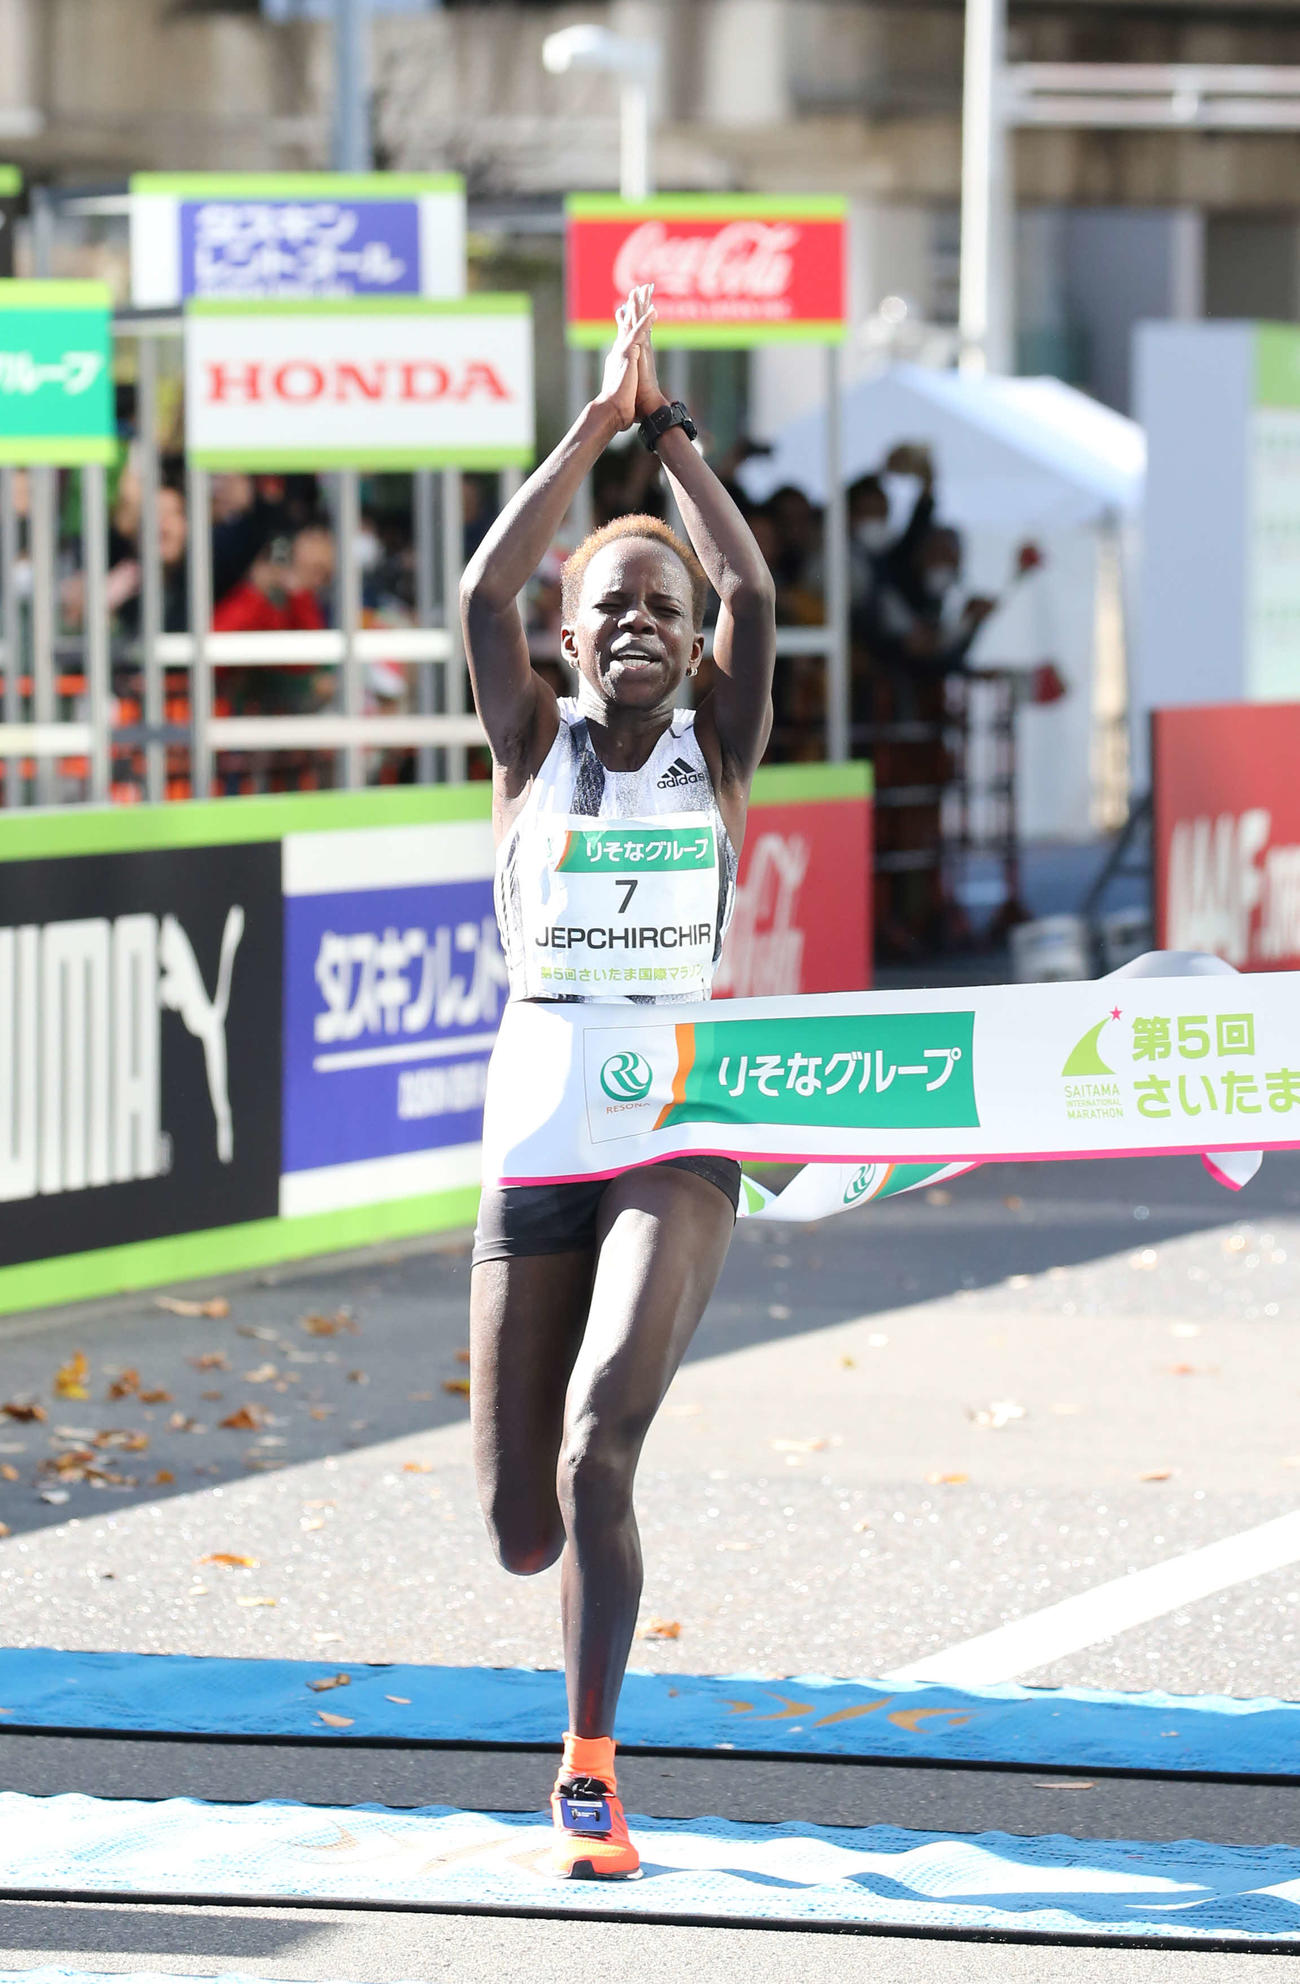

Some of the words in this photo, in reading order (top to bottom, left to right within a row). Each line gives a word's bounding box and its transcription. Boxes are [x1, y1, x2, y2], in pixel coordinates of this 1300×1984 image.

[0, 350, 105, 396] ループ
[208, 361, 512, 403] HONDA
[657, 772, 706, 789] adidas
[615, 879, 638, 914] 7
[535, 922, 711, 949] JEPCHIRCHIR
[1131, 1013, 1256, 1062] 第5回
[718, 1046, 962, 1098] りそなグループ
[1064, 1083, 1121, 1098] SAITAMA
[1133, 1067, 1300, 1119] さいたま
[1067, 1107, 1124, 1120] MARATHON
